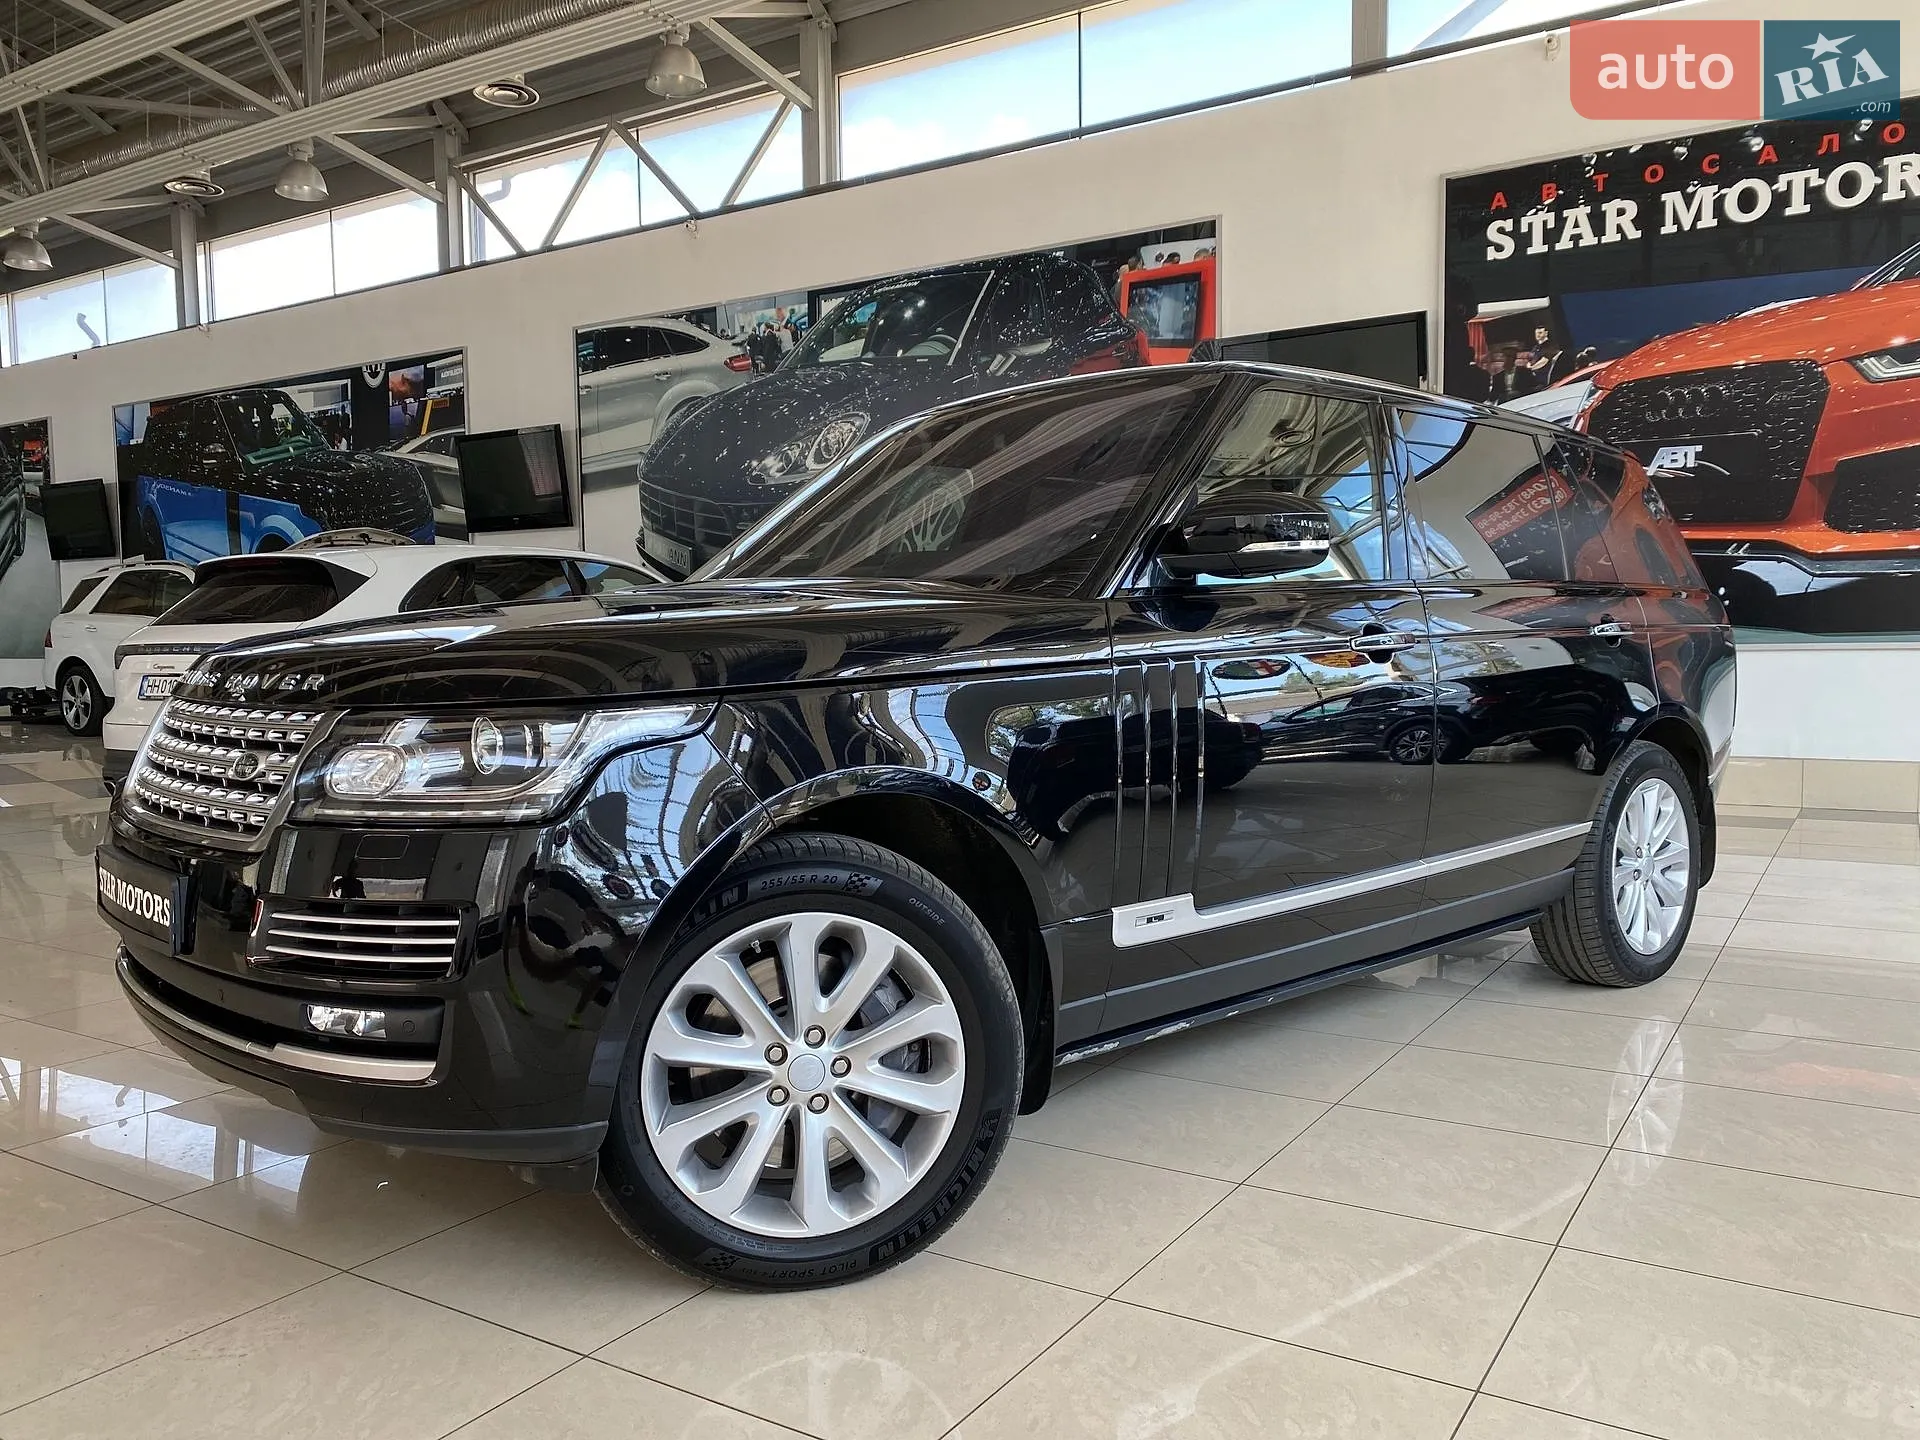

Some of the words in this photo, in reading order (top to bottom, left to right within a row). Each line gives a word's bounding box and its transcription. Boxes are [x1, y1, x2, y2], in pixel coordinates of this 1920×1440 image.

[1486, 197, 1642, 261] STAR
[1647, 444, 1703, 476] ABT
[99, 866, 116, 902] STAR
[117, 878, 171, 928] MOTORS
[761, 873, 805, 890] 255/55
[810, 873, 817, 884] R
[823, 873, 838, 885] 20
[908, 897, 945, 927] OUTSIDE
[877, 1146, 986, 1262] MICHELIN
[768, 1267, 815, 1280] SPORT
[820, 1259, 857, 1276] PILOT
